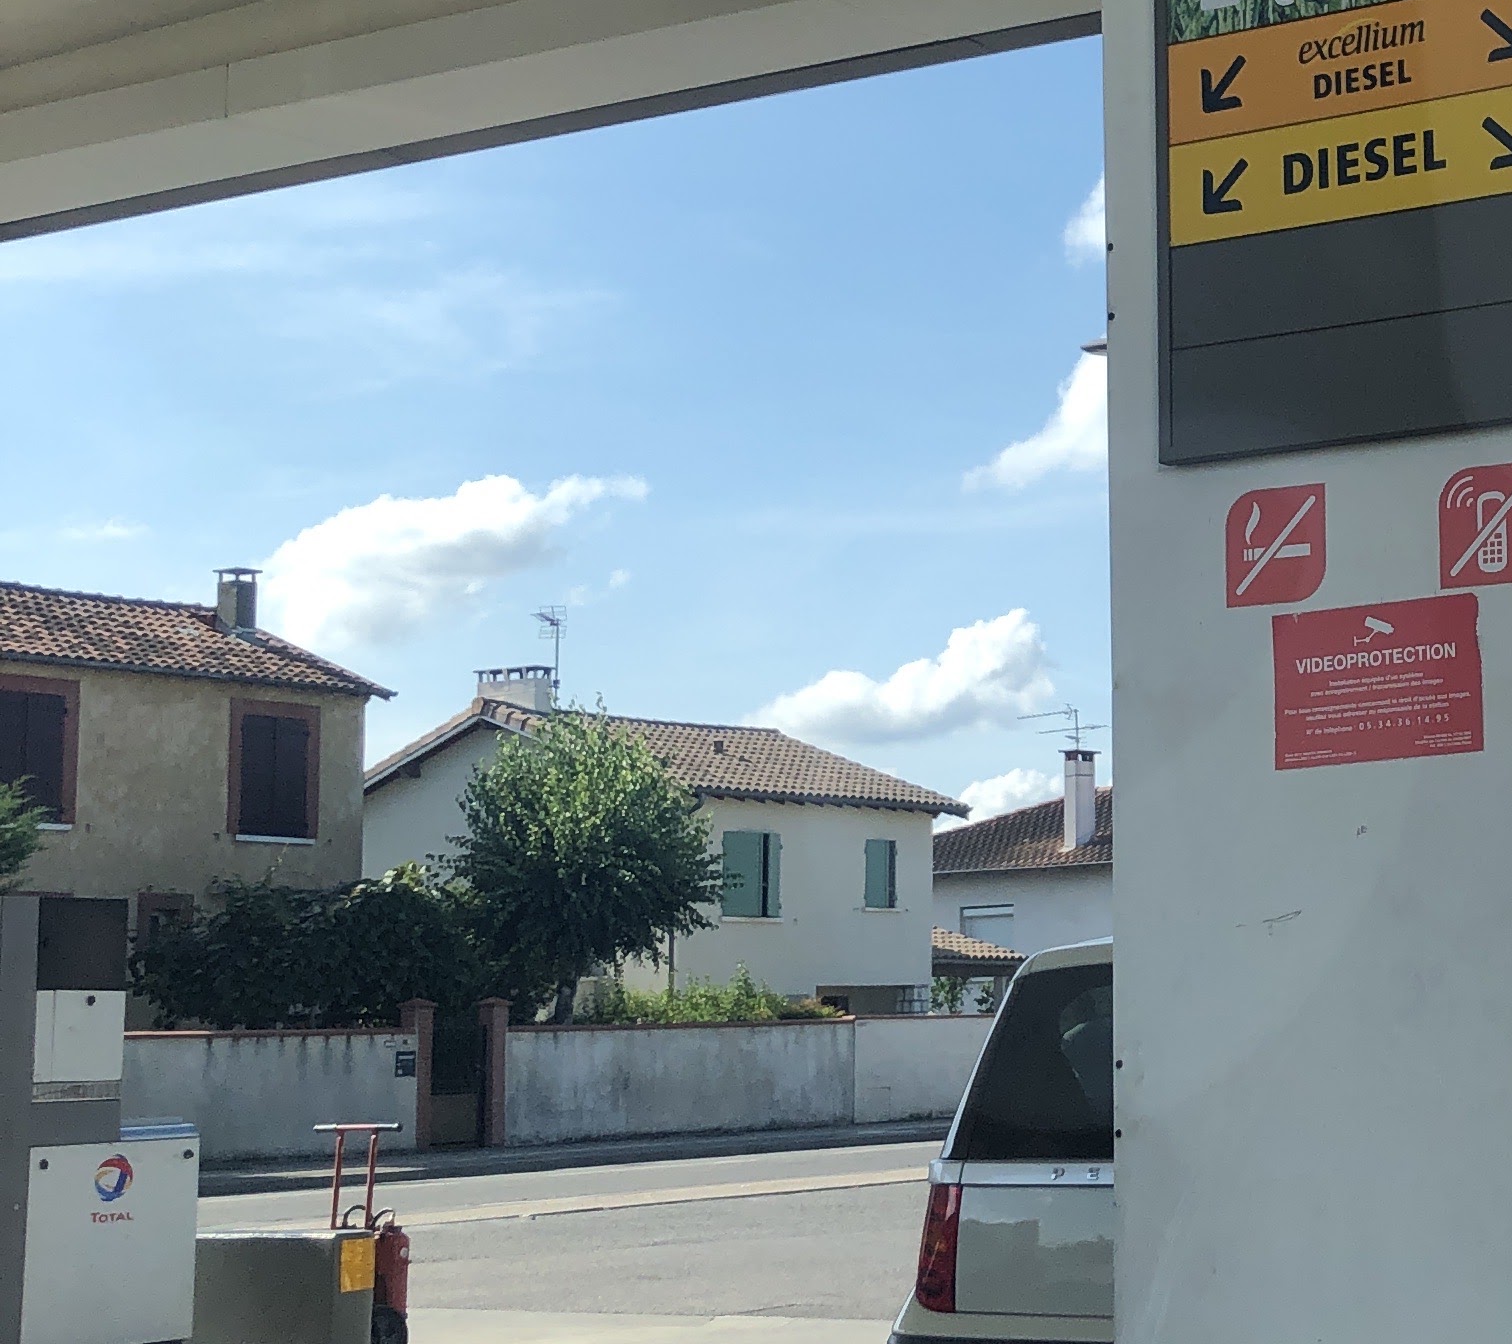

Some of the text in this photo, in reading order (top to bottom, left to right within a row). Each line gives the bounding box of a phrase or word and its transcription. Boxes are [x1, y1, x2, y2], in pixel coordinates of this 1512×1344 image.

[1298, 18, 1426, 65] excellium
[1313, 59, 1412, 99] DIESEL
[1282, 129, 1447, 196] DIESEL
[1296, 642, 1457, 674] VIDEOPROTECTION
[90, 1211, 134, 1223] TOTAL
